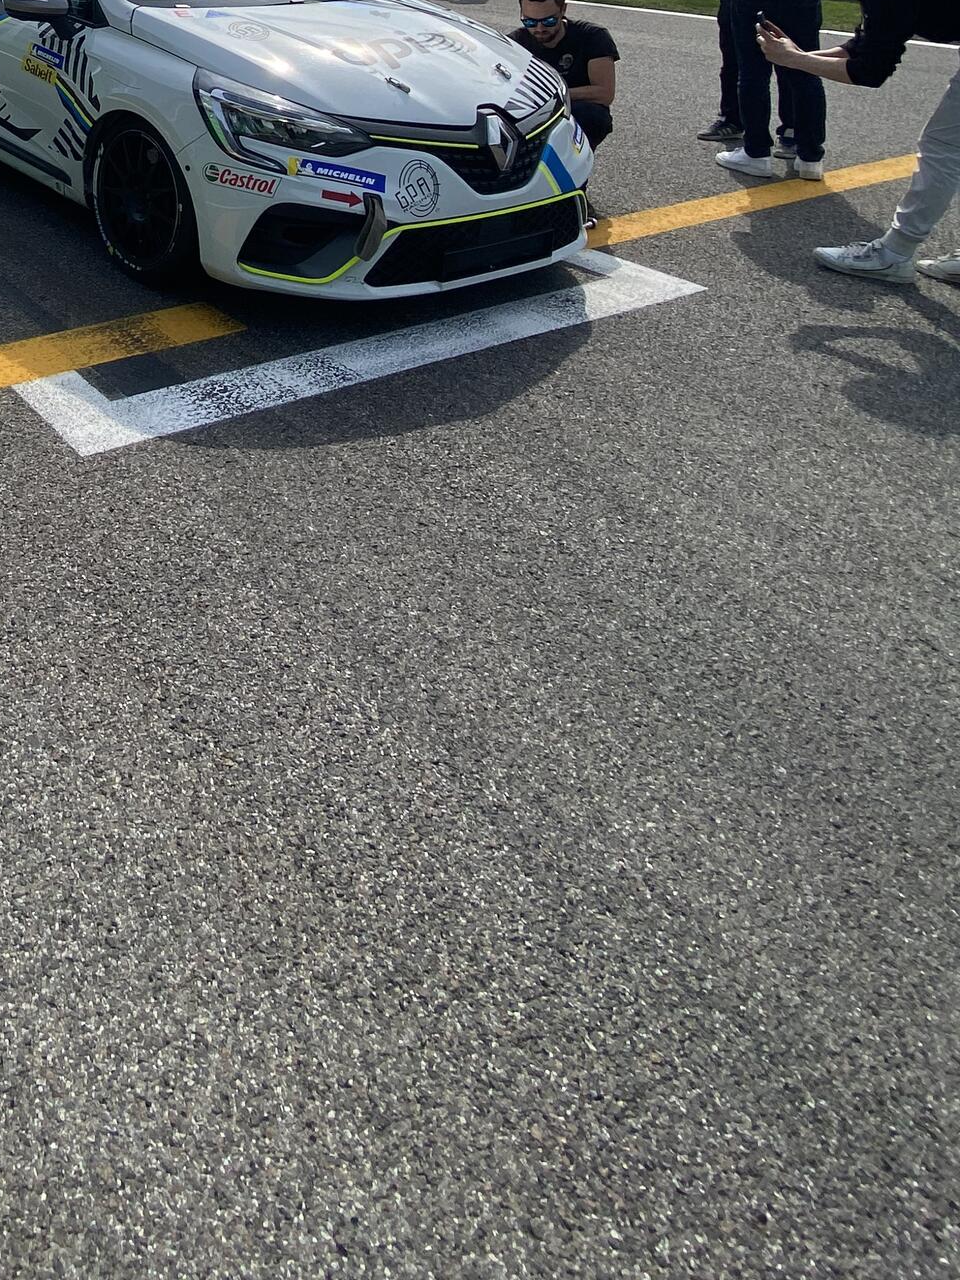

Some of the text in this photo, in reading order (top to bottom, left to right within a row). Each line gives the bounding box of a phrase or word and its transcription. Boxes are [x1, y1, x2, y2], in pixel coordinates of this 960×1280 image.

[24, 58, 53, 84] Sabelt
[218, 168, 277, 196] Castrol
[316, 166, 377, 186] MICHELIN
[395, 176, 431, 209] GPA
